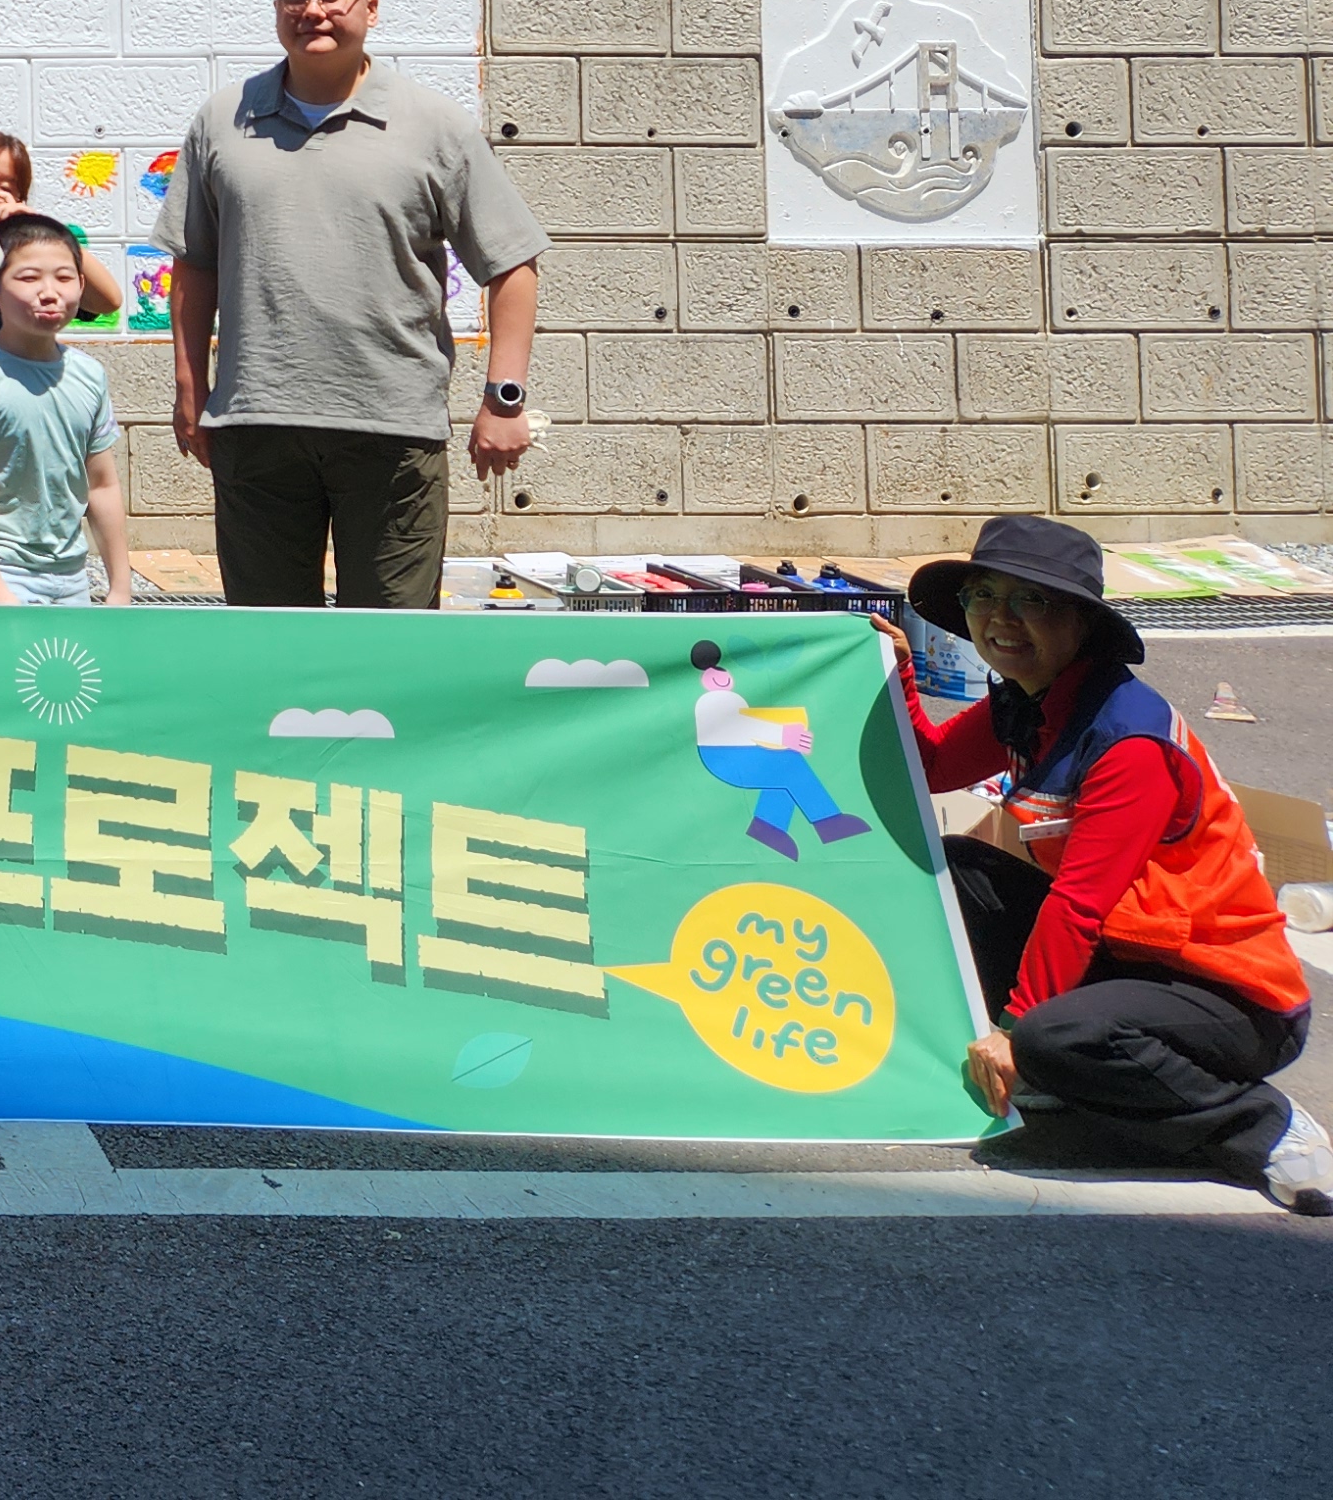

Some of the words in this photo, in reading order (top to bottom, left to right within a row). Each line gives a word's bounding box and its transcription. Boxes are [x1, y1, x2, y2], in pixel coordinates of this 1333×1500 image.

[736, 912, 829, 963] my
[689, 938, 873, 1026] green
[731, 1005, 840, 1066] life
